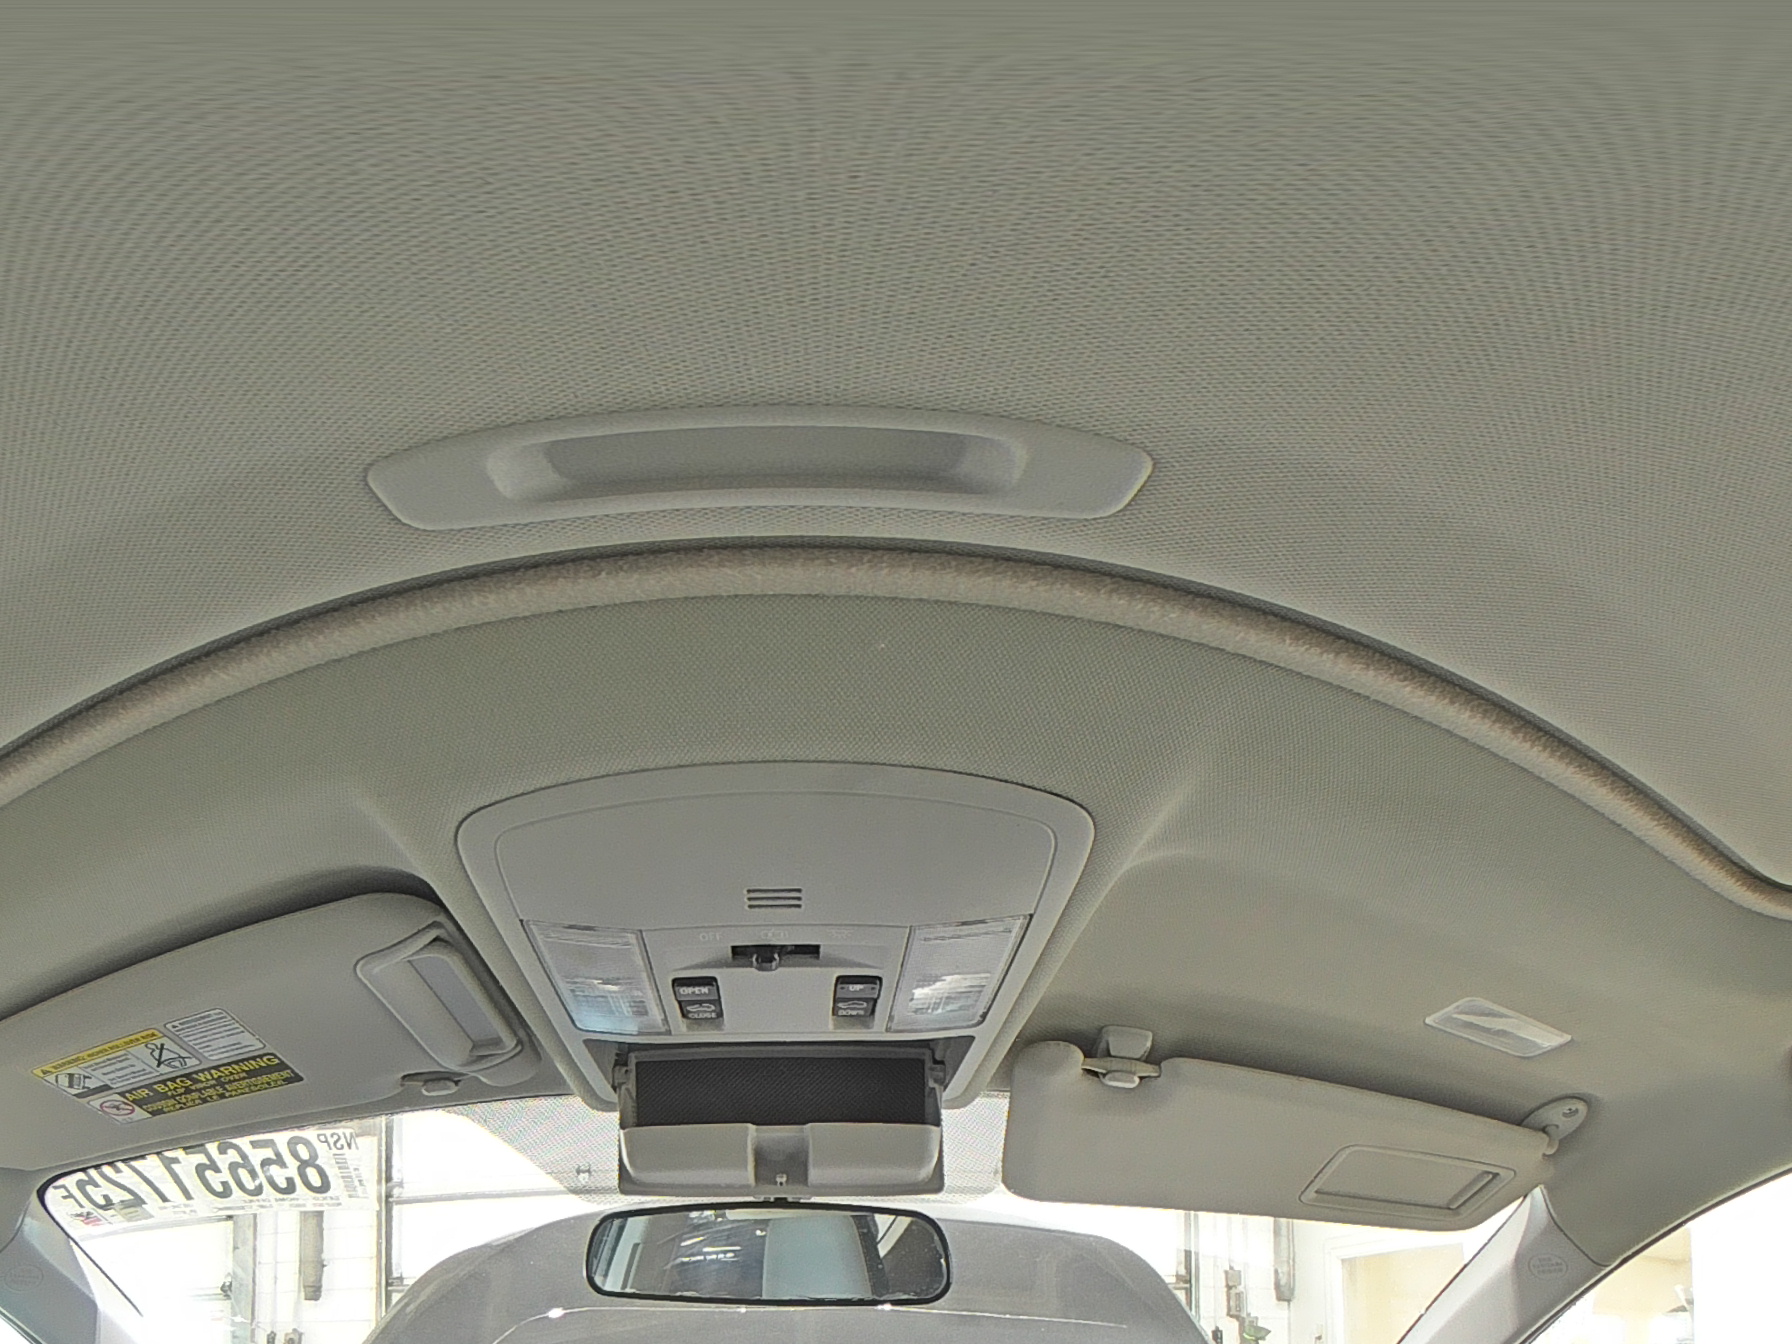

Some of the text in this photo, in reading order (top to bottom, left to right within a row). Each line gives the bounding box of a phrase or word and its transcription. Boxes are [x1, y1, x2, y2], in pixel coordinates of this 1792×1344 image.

[698, 932, 722, 942] OFF
[679, 987, 709, 995] OPEN
[848, 984, 864, 992] UP
[124, 1055, 281, 1102] AIR BAG WARNING
